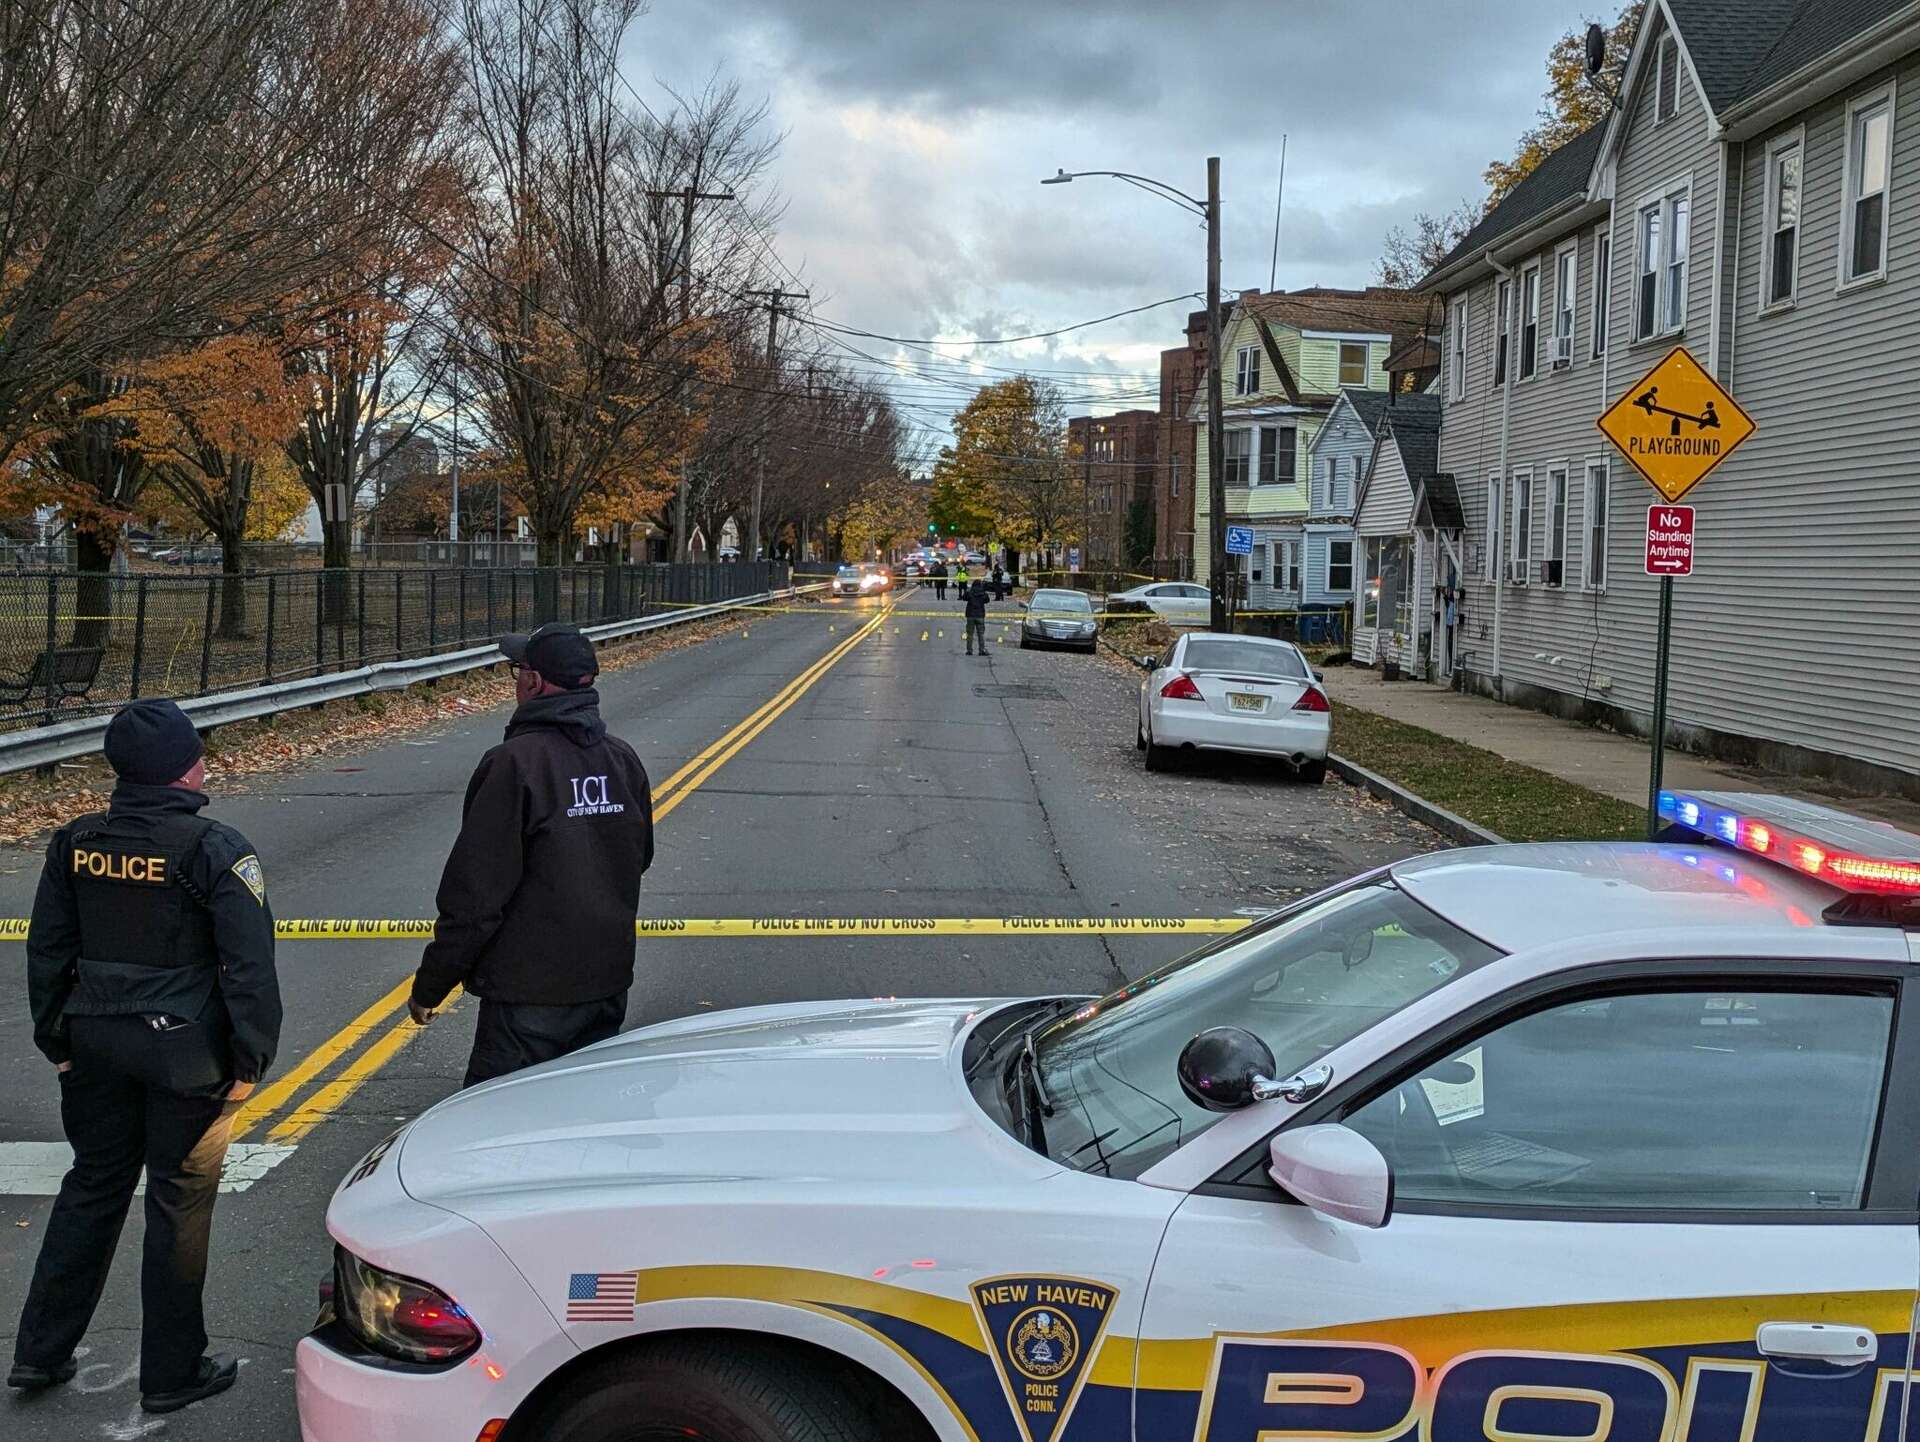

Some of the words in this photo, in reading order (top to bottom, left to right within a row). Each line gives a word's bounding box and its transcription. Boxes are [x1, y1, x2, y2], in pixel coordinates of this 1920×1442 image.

[1629, 436, 1721, 456] PLAYGROUND
[1660, 514, 1681, 527] No
[1649, 530, 1693, 545] Standing
[1649, 545, 1690, 559] Anytime
[570, 775, 610, 808] LCI
[567, 808, 578, 818] CITY
[585, 806, 598, 815] NEW
[600, 804, 624, 814] HAVEN
[73, 849, 166, 882] POLICE
[299, 920, 329, 933] LINE
[333, 920, 350, 933] DO
[356, 920, 382, 933] NOT
[388, 920, 433, 933] CROSS
[641, 920, 687, 931] CROSS
[752, 919, 800, 930] POLICE
[804, 919, 834, 930] LINE
[838, 919, 857, 930] DO
[861, 919, 887, 930] NOT
[892, 919, 937, 930] CROSS
[1002, 918, 1050, 929] POLICE
[1054, 918, 1084, 929] LINE
[1088, 918, 1106, 929] DO
[1111, 918, 1137, 929] NOT
[1141, 918, 1186, 929] CROSS
[981, 1285, 1029, 1306] NEW
[1037, 1284, 1107, 1311] HAVEN
[1025, 1383, 1059, 1397] POLICE
[1026, 1400, 1057, 1413] CONN.
